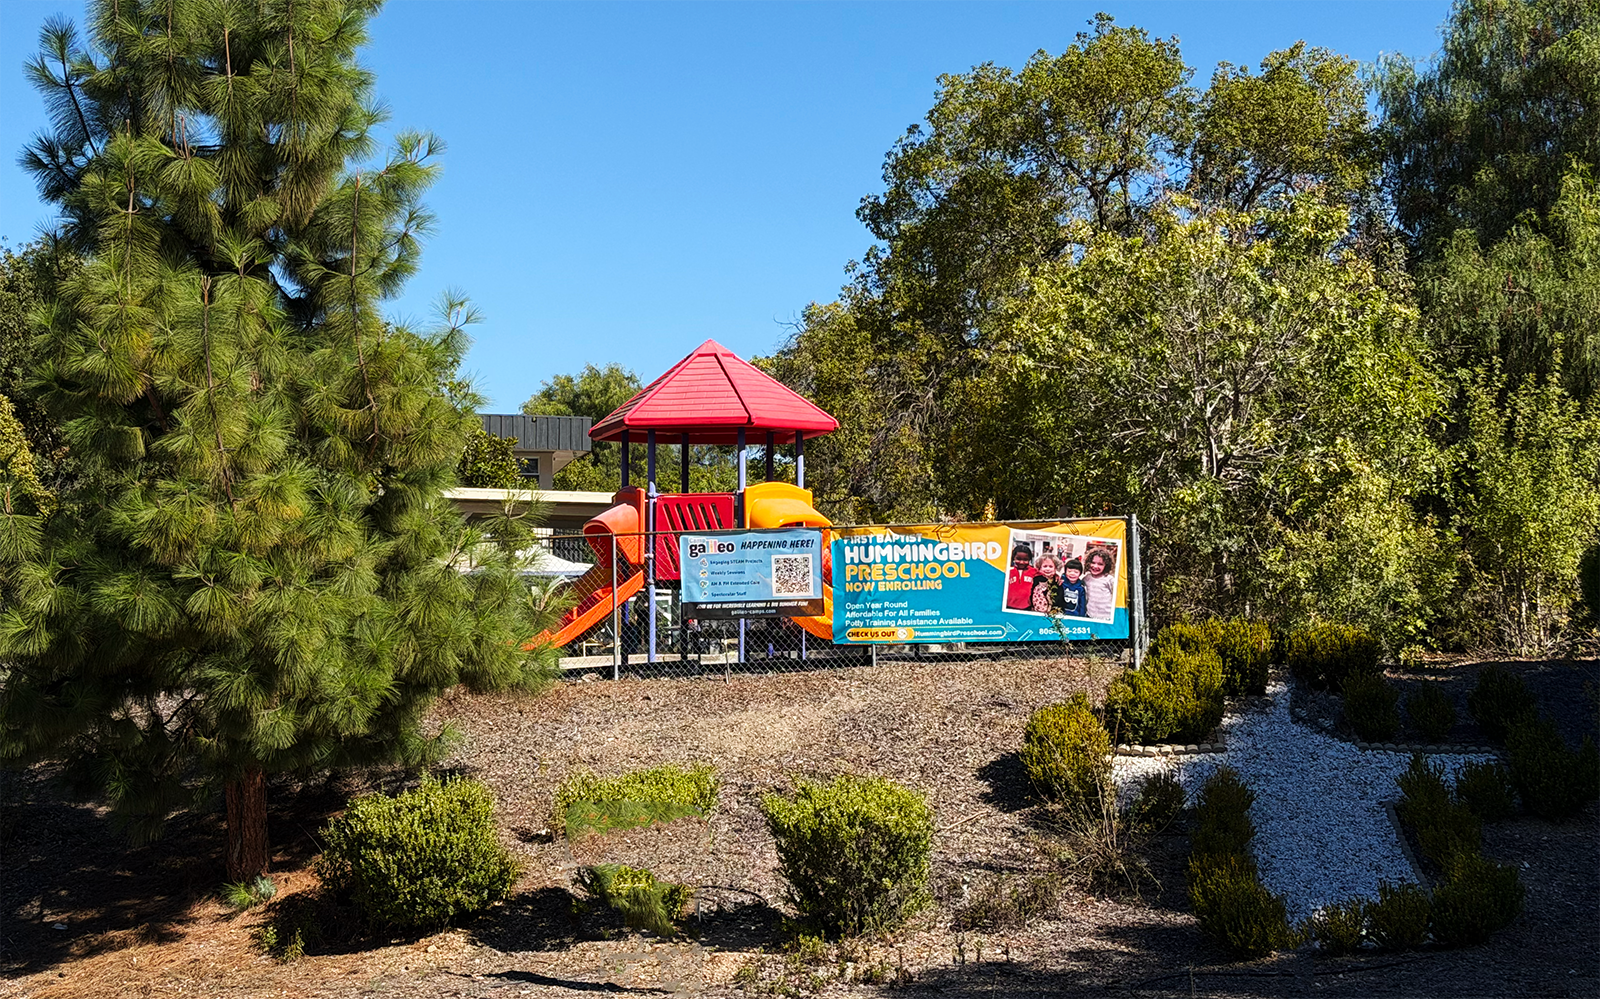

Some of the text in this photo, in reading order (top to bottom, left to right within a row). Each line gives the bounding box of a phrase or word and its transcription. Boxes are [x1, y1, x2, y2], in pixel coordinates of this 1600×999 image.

[876, 532, 922, 543] BAPTIST
[688, 540, 735, 558] galileo
[740, 538, 814, 550] HAPPENING HERE!
[844, 541, 1002, 564] HUMMINGBIRD
[845, 562, 970, 581] PRESCHOOL
[845, 580, 942, 592] NOW ENROLLING
[865, 619, 896, 627] Training
